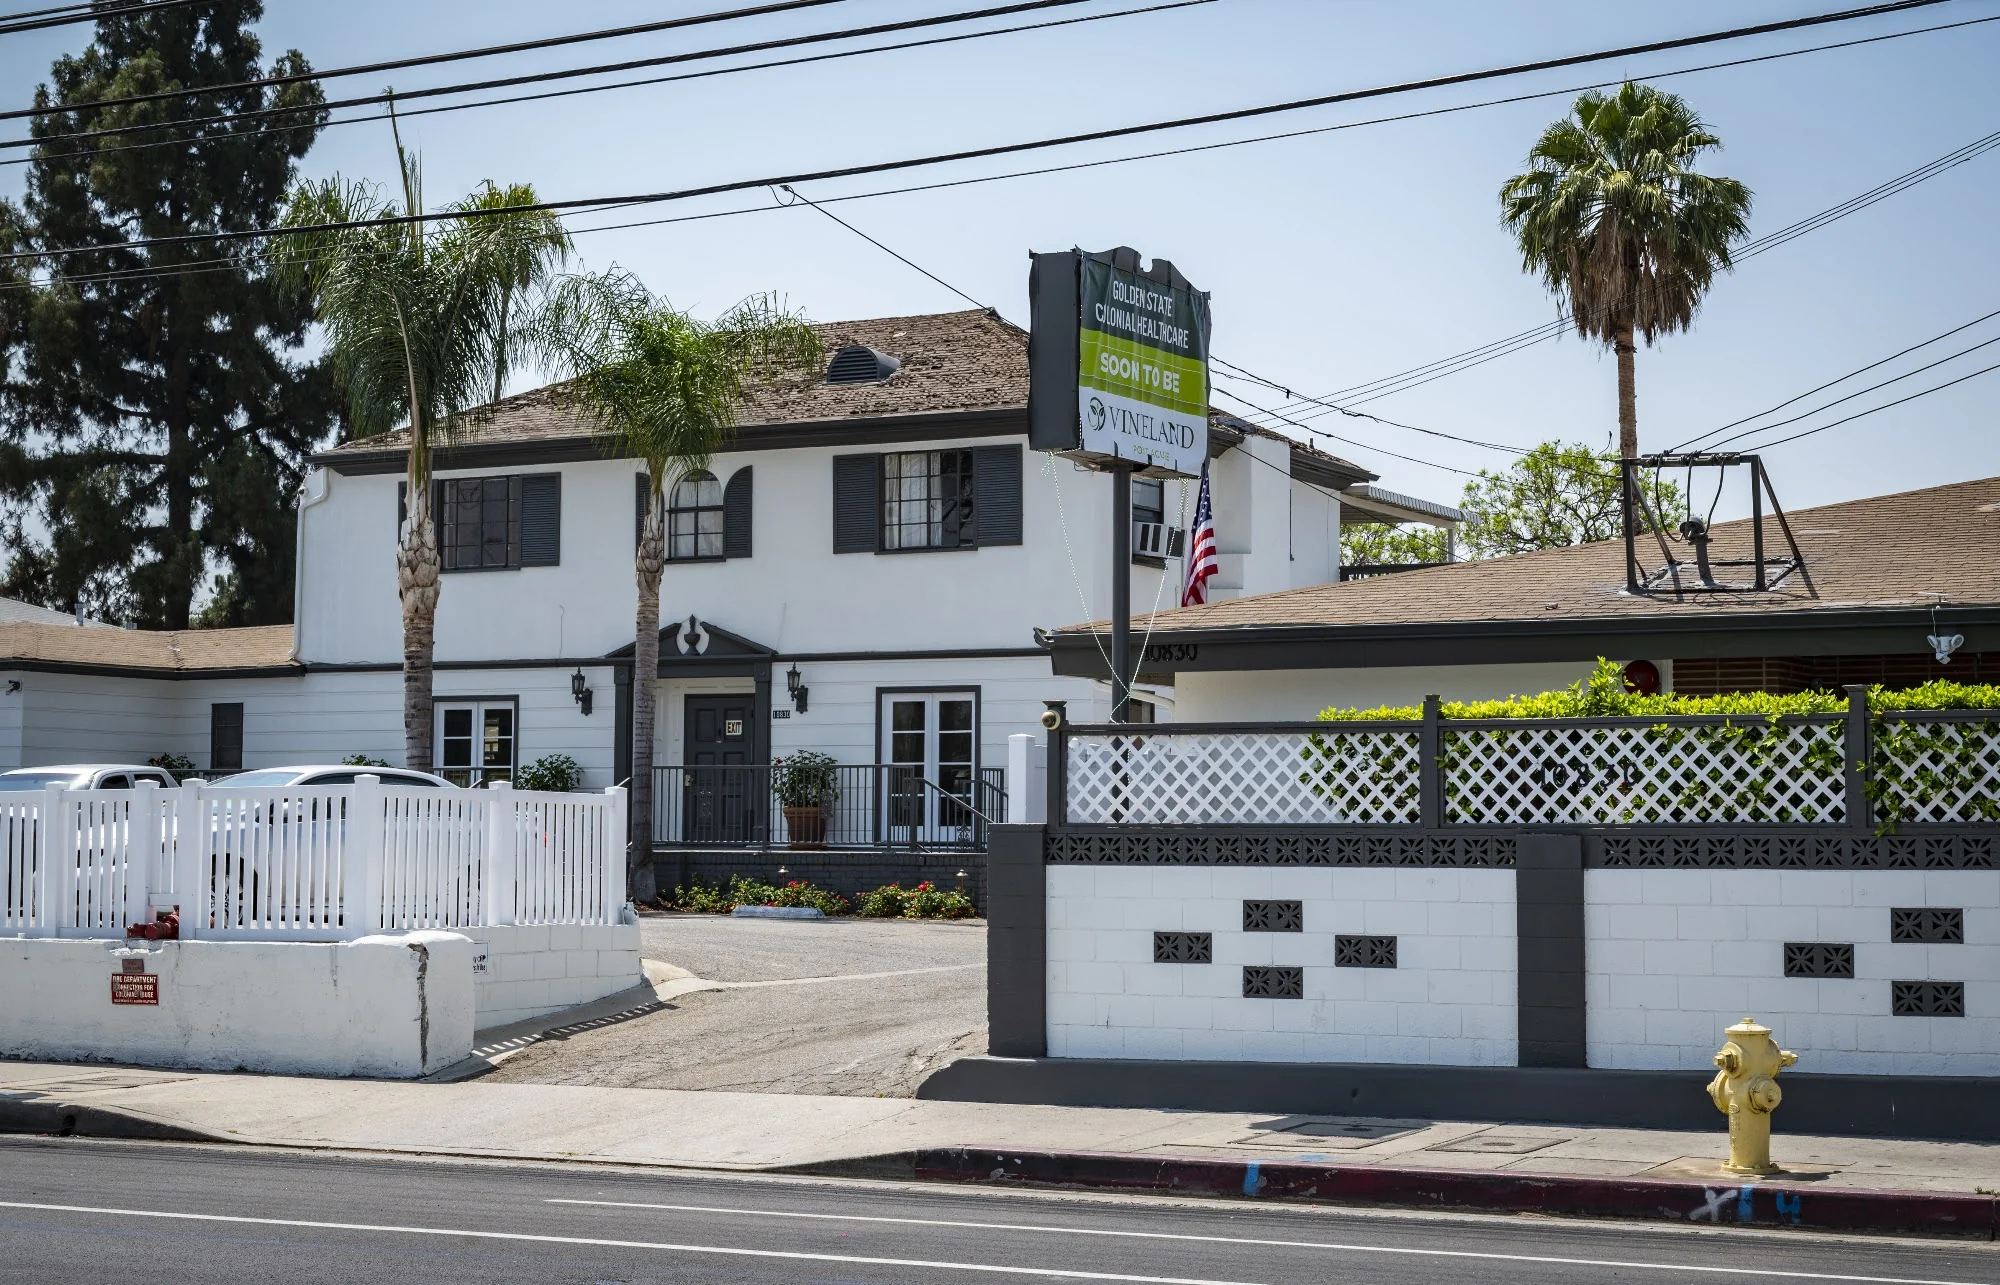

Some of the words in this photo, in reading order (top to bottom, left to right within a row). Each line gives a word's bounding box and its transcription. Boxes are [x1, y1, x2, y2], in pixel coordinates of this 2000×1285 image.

[1113, 281, 1145, 307] GOLDEN
[1147, 292, 1173, 317] STATE
[1137, 315, 1189, 349] HEALTHCARE
[1101, 352, 1140, 382] SOON
[1143, 364, 1160, 387] TO
[1163, 370, 1180, 394] BE
[1108, 406, 1195, 449] VINELAND
[1151, 449, 1170, 461] ACUE
[1145, 644, 1198, 662] 10830
[727, 721, 742, 733] EXIT
[1540, 763, 1640, 788] 10830
[123, 976, 157, 984] DEPARTMENT
